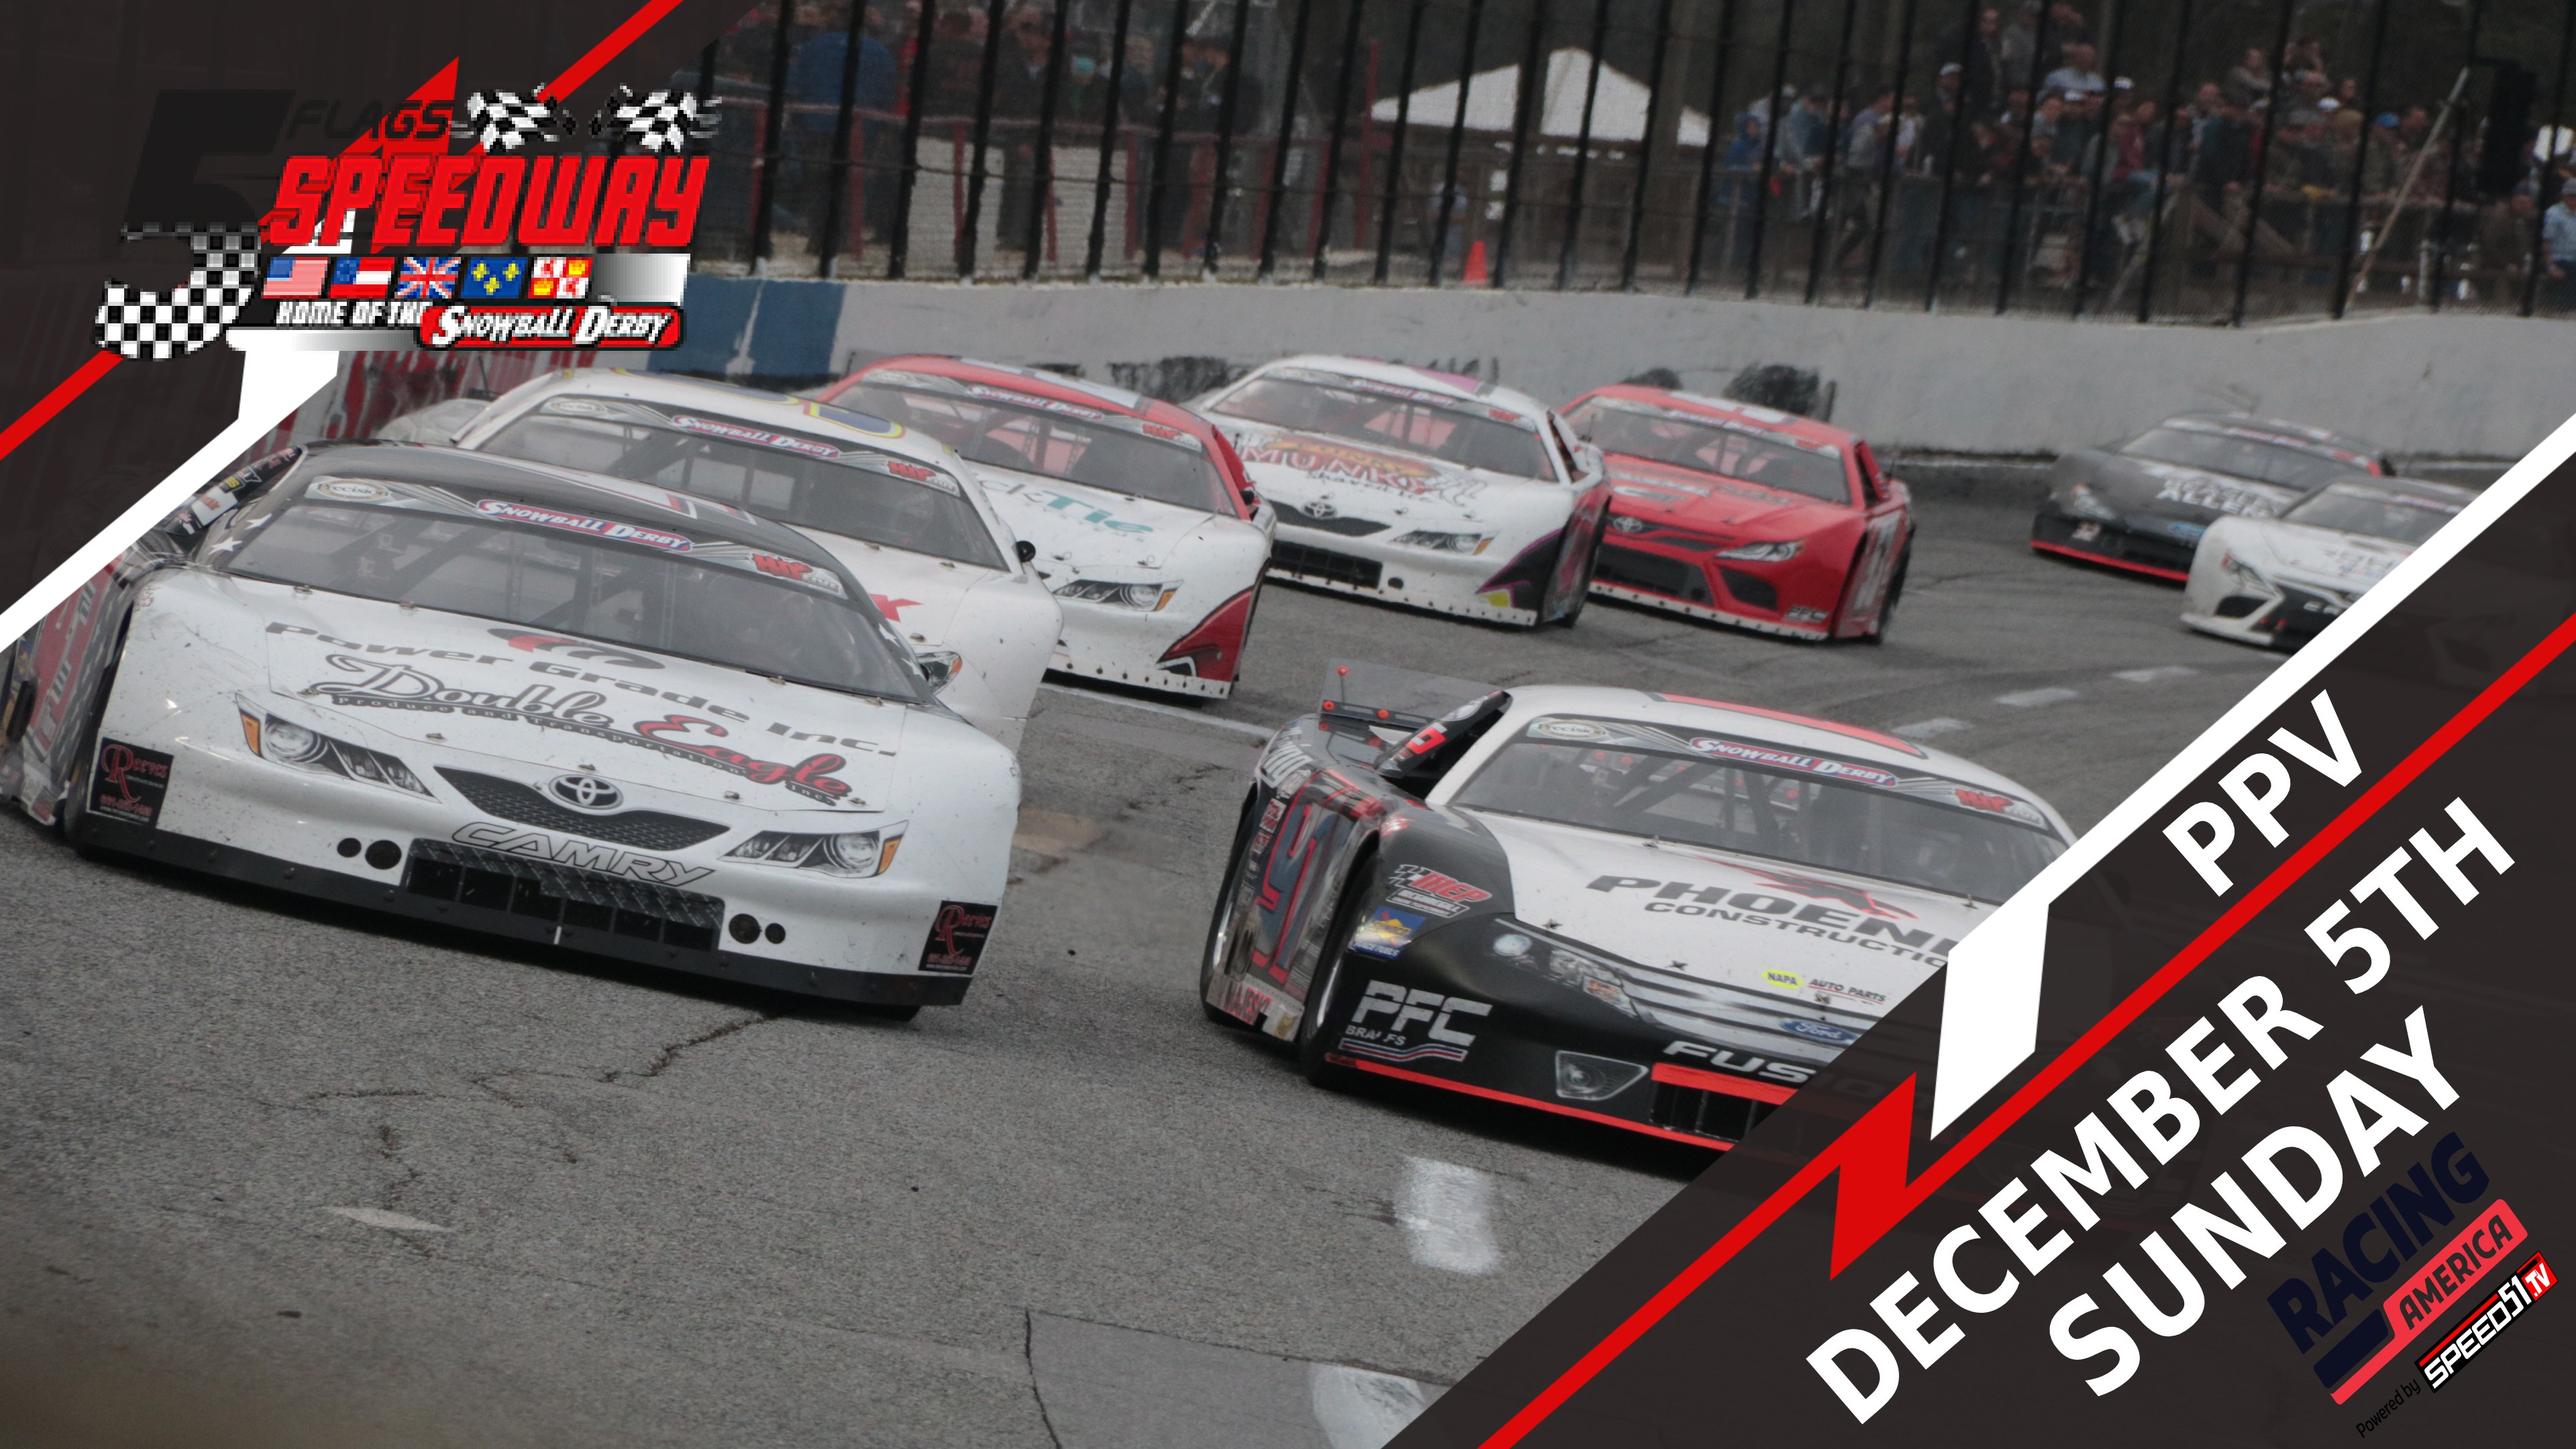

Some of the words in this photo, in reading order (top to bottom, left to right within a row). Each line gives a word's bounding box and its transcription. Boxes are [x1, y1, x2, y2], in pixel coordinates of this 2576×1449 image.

[675, 417, 771, 442] SNOWBALL
[770, 435, 839, 457] DERBY
[317, 482, 388, 498] Precision
[478, 501, 604, 532] SNOWBALL
[604, 521, 690, 548] DERBY
[266, 621, 514, 665] Power
[528, 661, 751, 722] Grade
[766, 721, 898, 757] Inc.
[309, 653, 614, 727] Double
[633, 714, 852, 796] Eagle
[468, 708, 513, 720] and
[1692, 739, 1813, 768] SNOWBALL
[1813, 759, 1896, 785] DERBY
[451, 821, 716, 887] CAMRY
[1768, 971, 1797, 986] NAPA
[1809, 979, 1844, 991] AUTO
[1848, 987, 1886, 1002] PARTS
[1351, 979, 1493, 1047] PFC
[1794, 1022, 1842, 1040] Ford
[1344, 1024, 1407, 1046] BRAES
